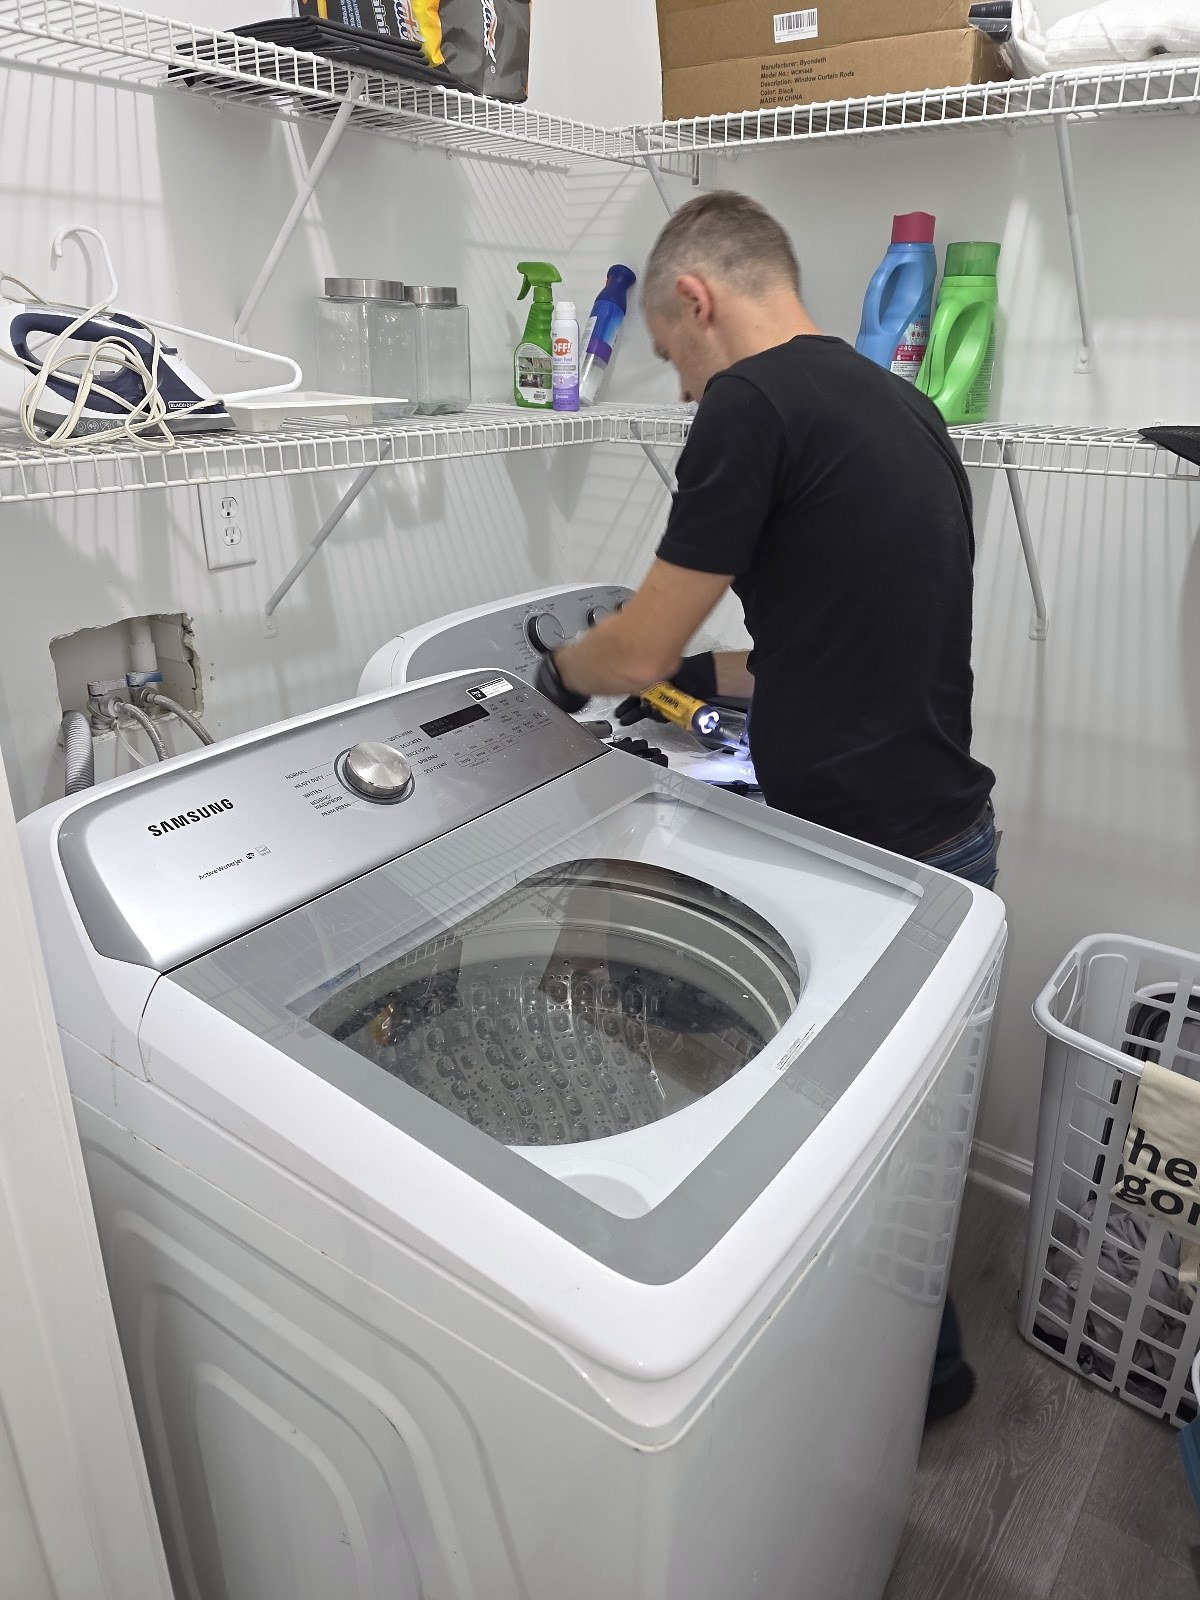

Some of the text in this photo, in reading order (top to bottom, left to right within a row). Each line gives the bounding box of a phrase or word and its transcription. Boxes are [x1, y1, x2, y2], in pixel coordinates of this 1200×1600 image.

[760, 61, 798, 71] Manufacturer:
[760, 71, 777, 79] Model
[760, 70, 855, 88] Description: Window Curtain Rods
[760, 87, 793, 96] Color: Black
[784, 94, 803, 102] CHINA
[553, 343, 571, 353] OFF!
[147, 798, 235, 837] SAMSUNG
